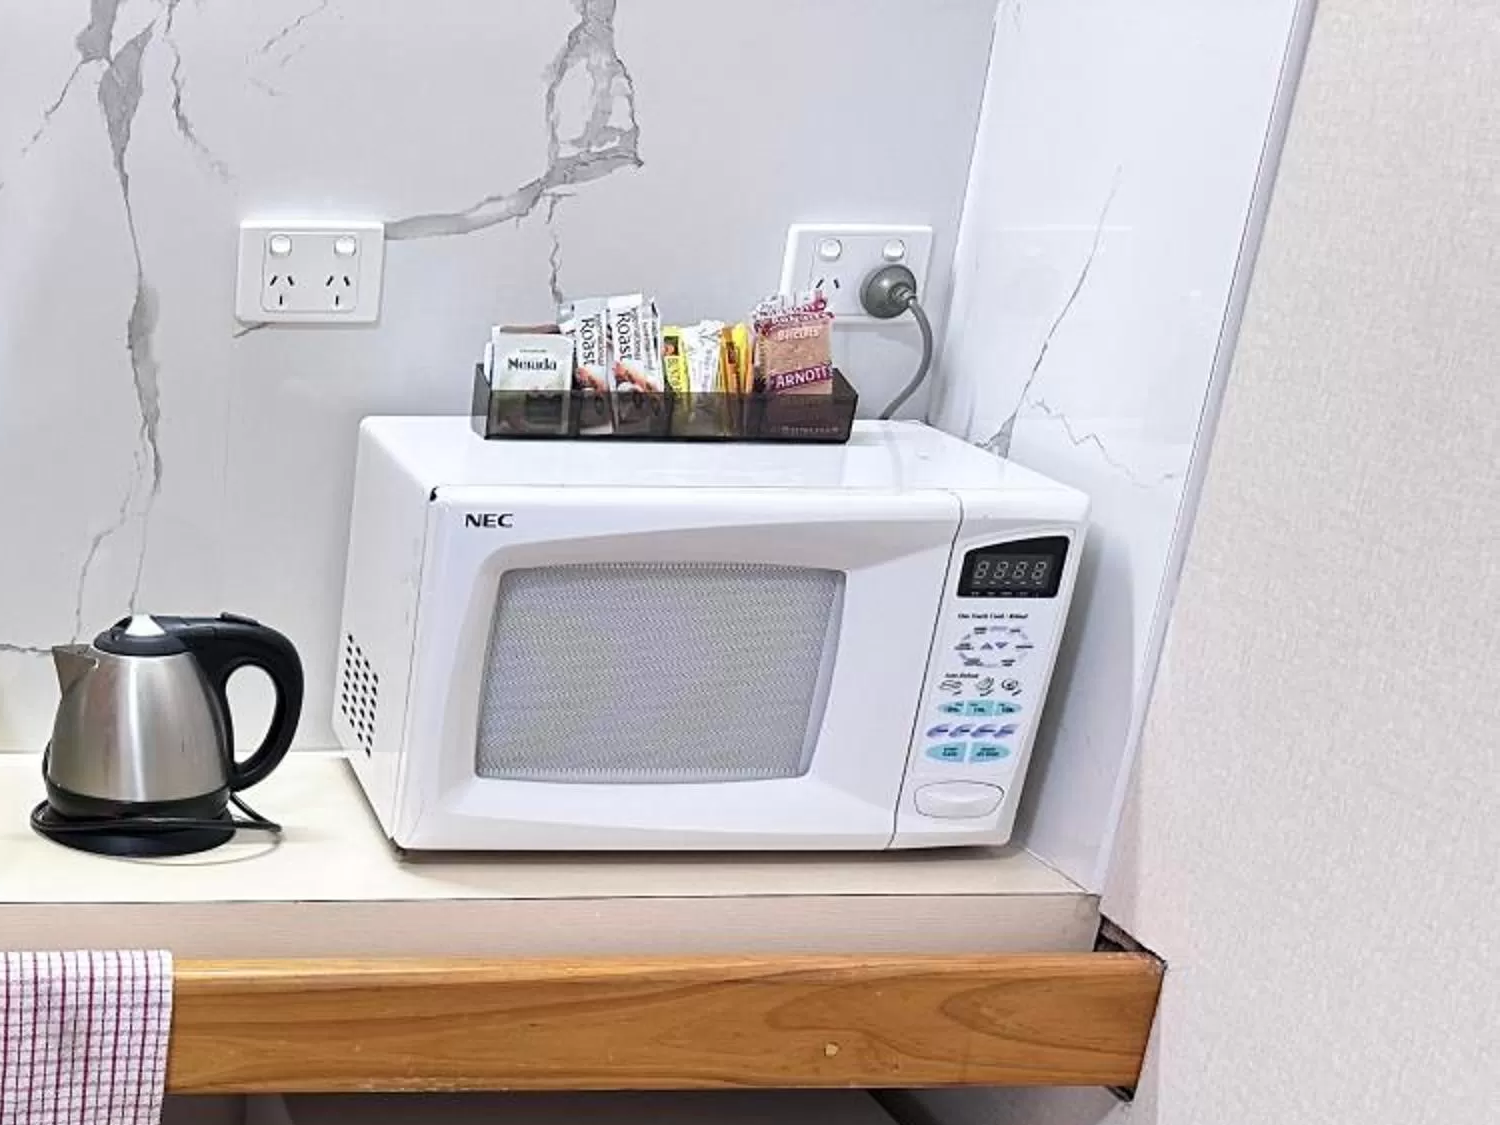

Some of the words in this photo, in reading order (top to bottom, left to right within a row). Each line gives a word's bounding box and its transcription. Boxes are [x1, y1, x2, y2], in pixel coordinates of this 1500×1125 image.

[581, 317, 596, 366] Roast
[617, 311, 632, 361] Roast
[465, 513, 514, 529] NEC
